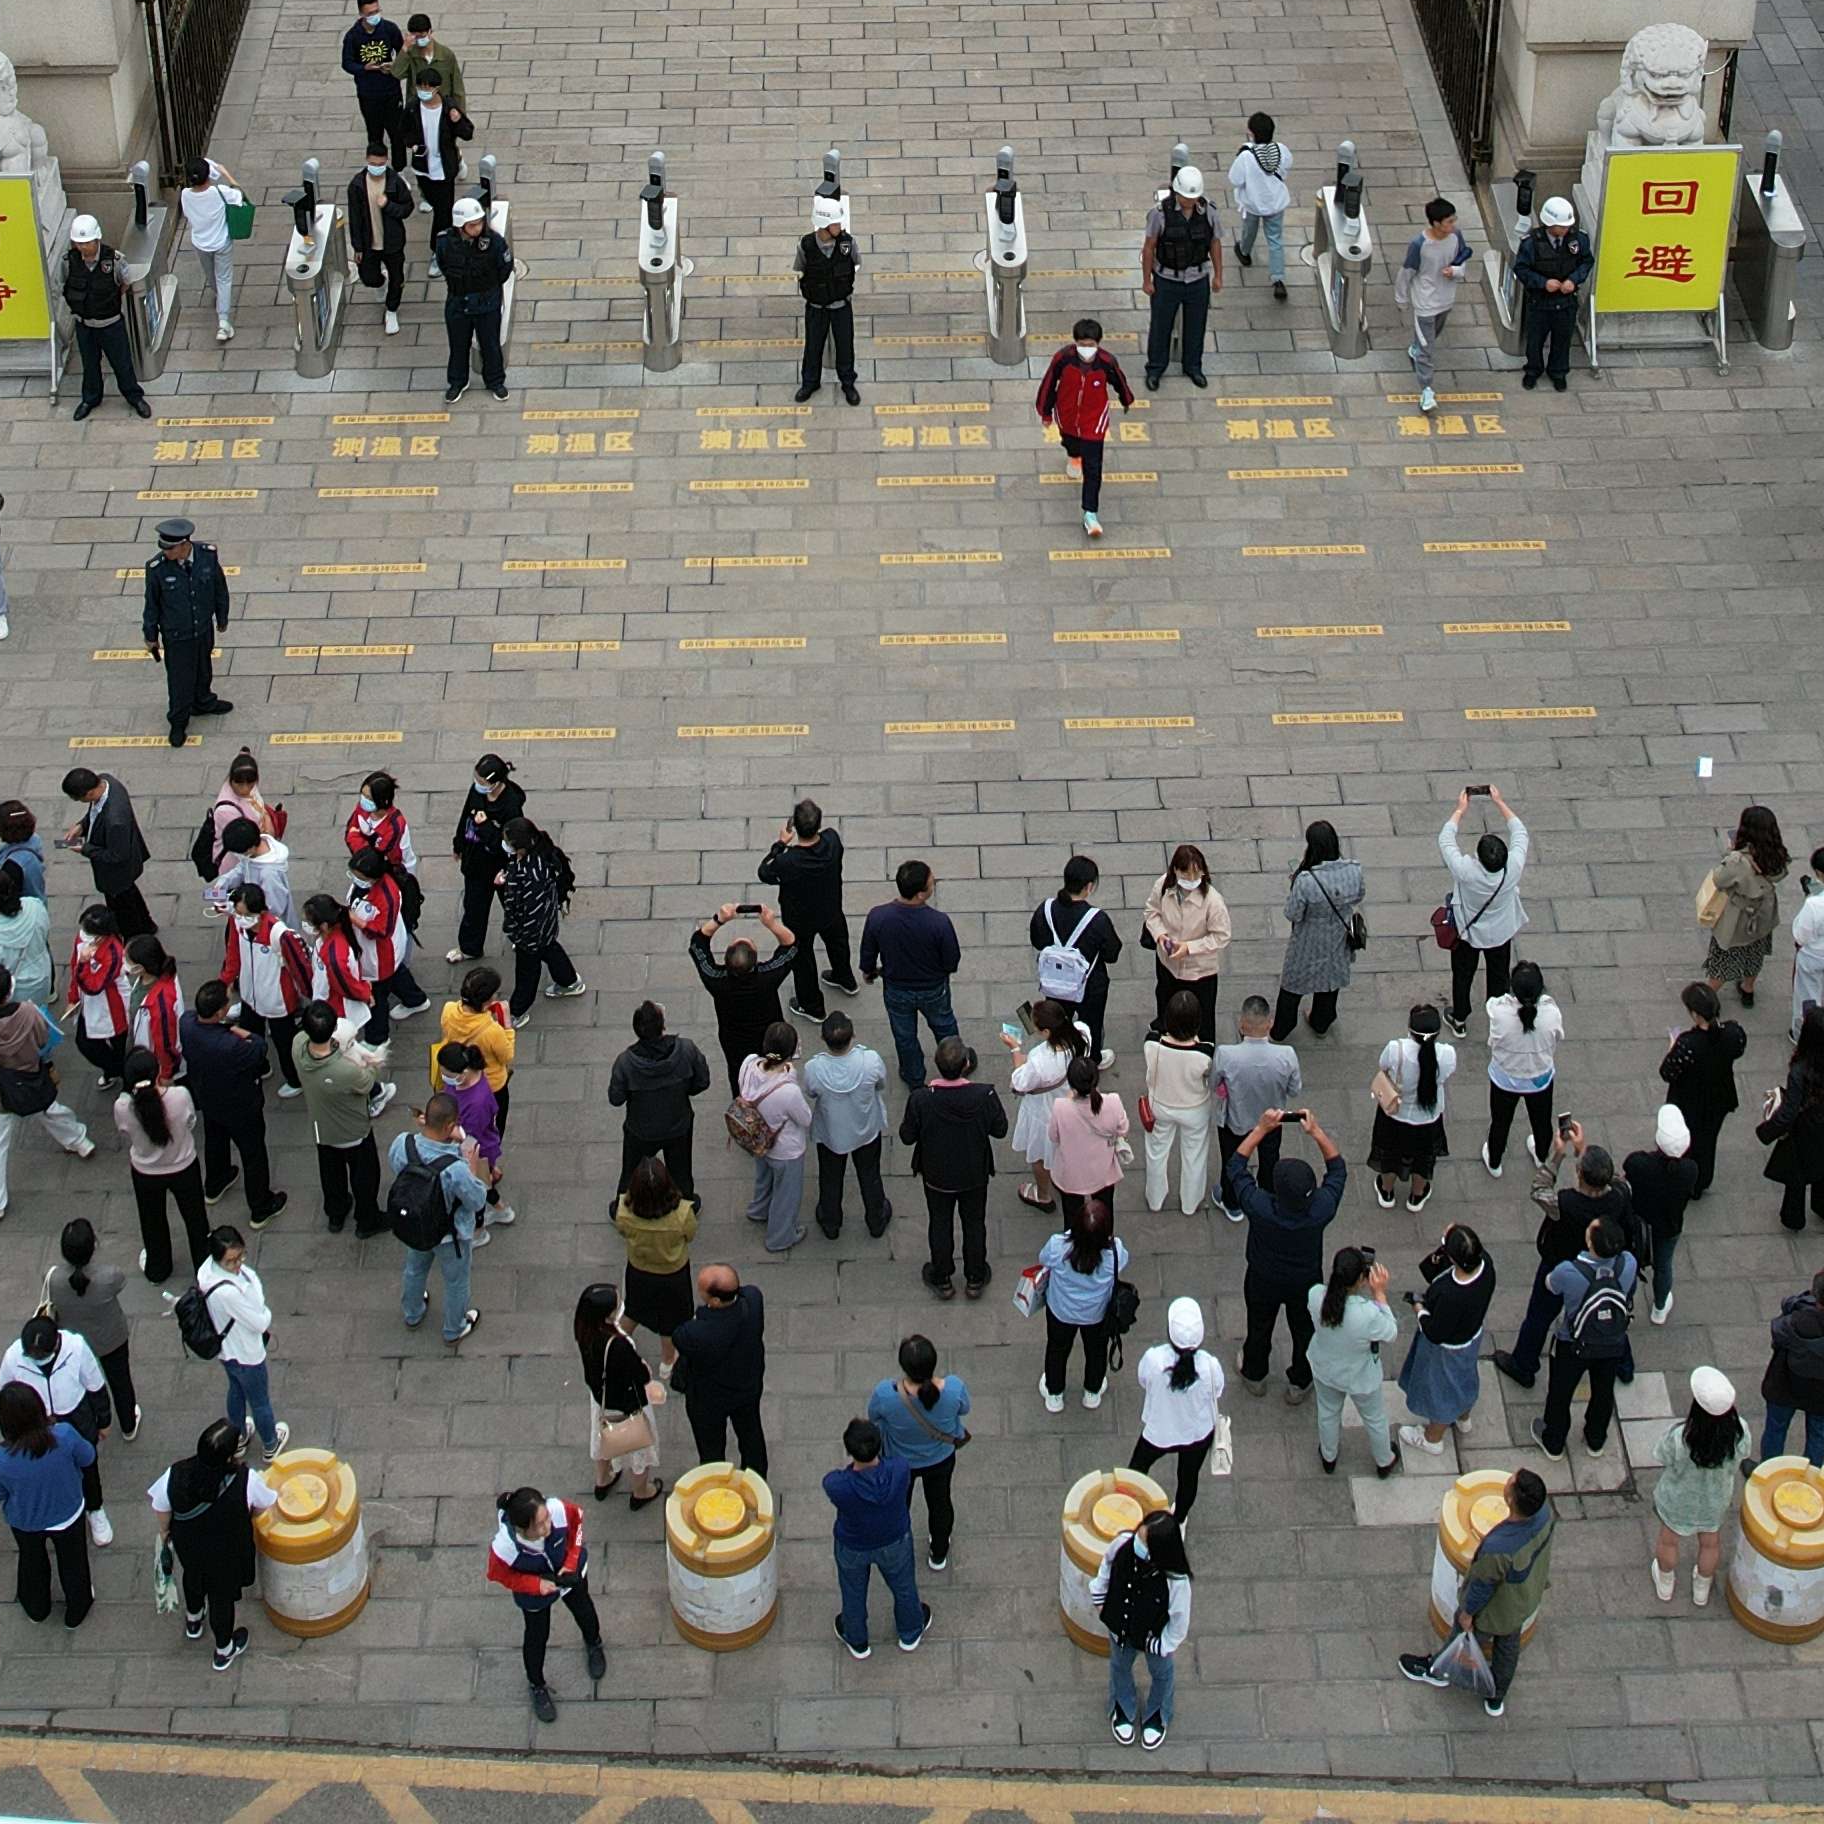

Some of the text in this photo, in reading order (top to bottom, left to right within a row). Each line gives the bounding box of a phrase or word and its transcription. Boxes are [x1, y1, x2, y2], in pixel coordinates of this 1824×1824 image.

[1624, 180, 1700, 283] 回避
[701, 428, 805, 449] 测温区
[884, 426, 985, 447] 测温区
[1227, 417, 1335, 440] 测温区
[155, 438, 258, 460] 测温区
[332, 436, 437, 457] 测温区
[528, 432, 631, 453] 测温区
